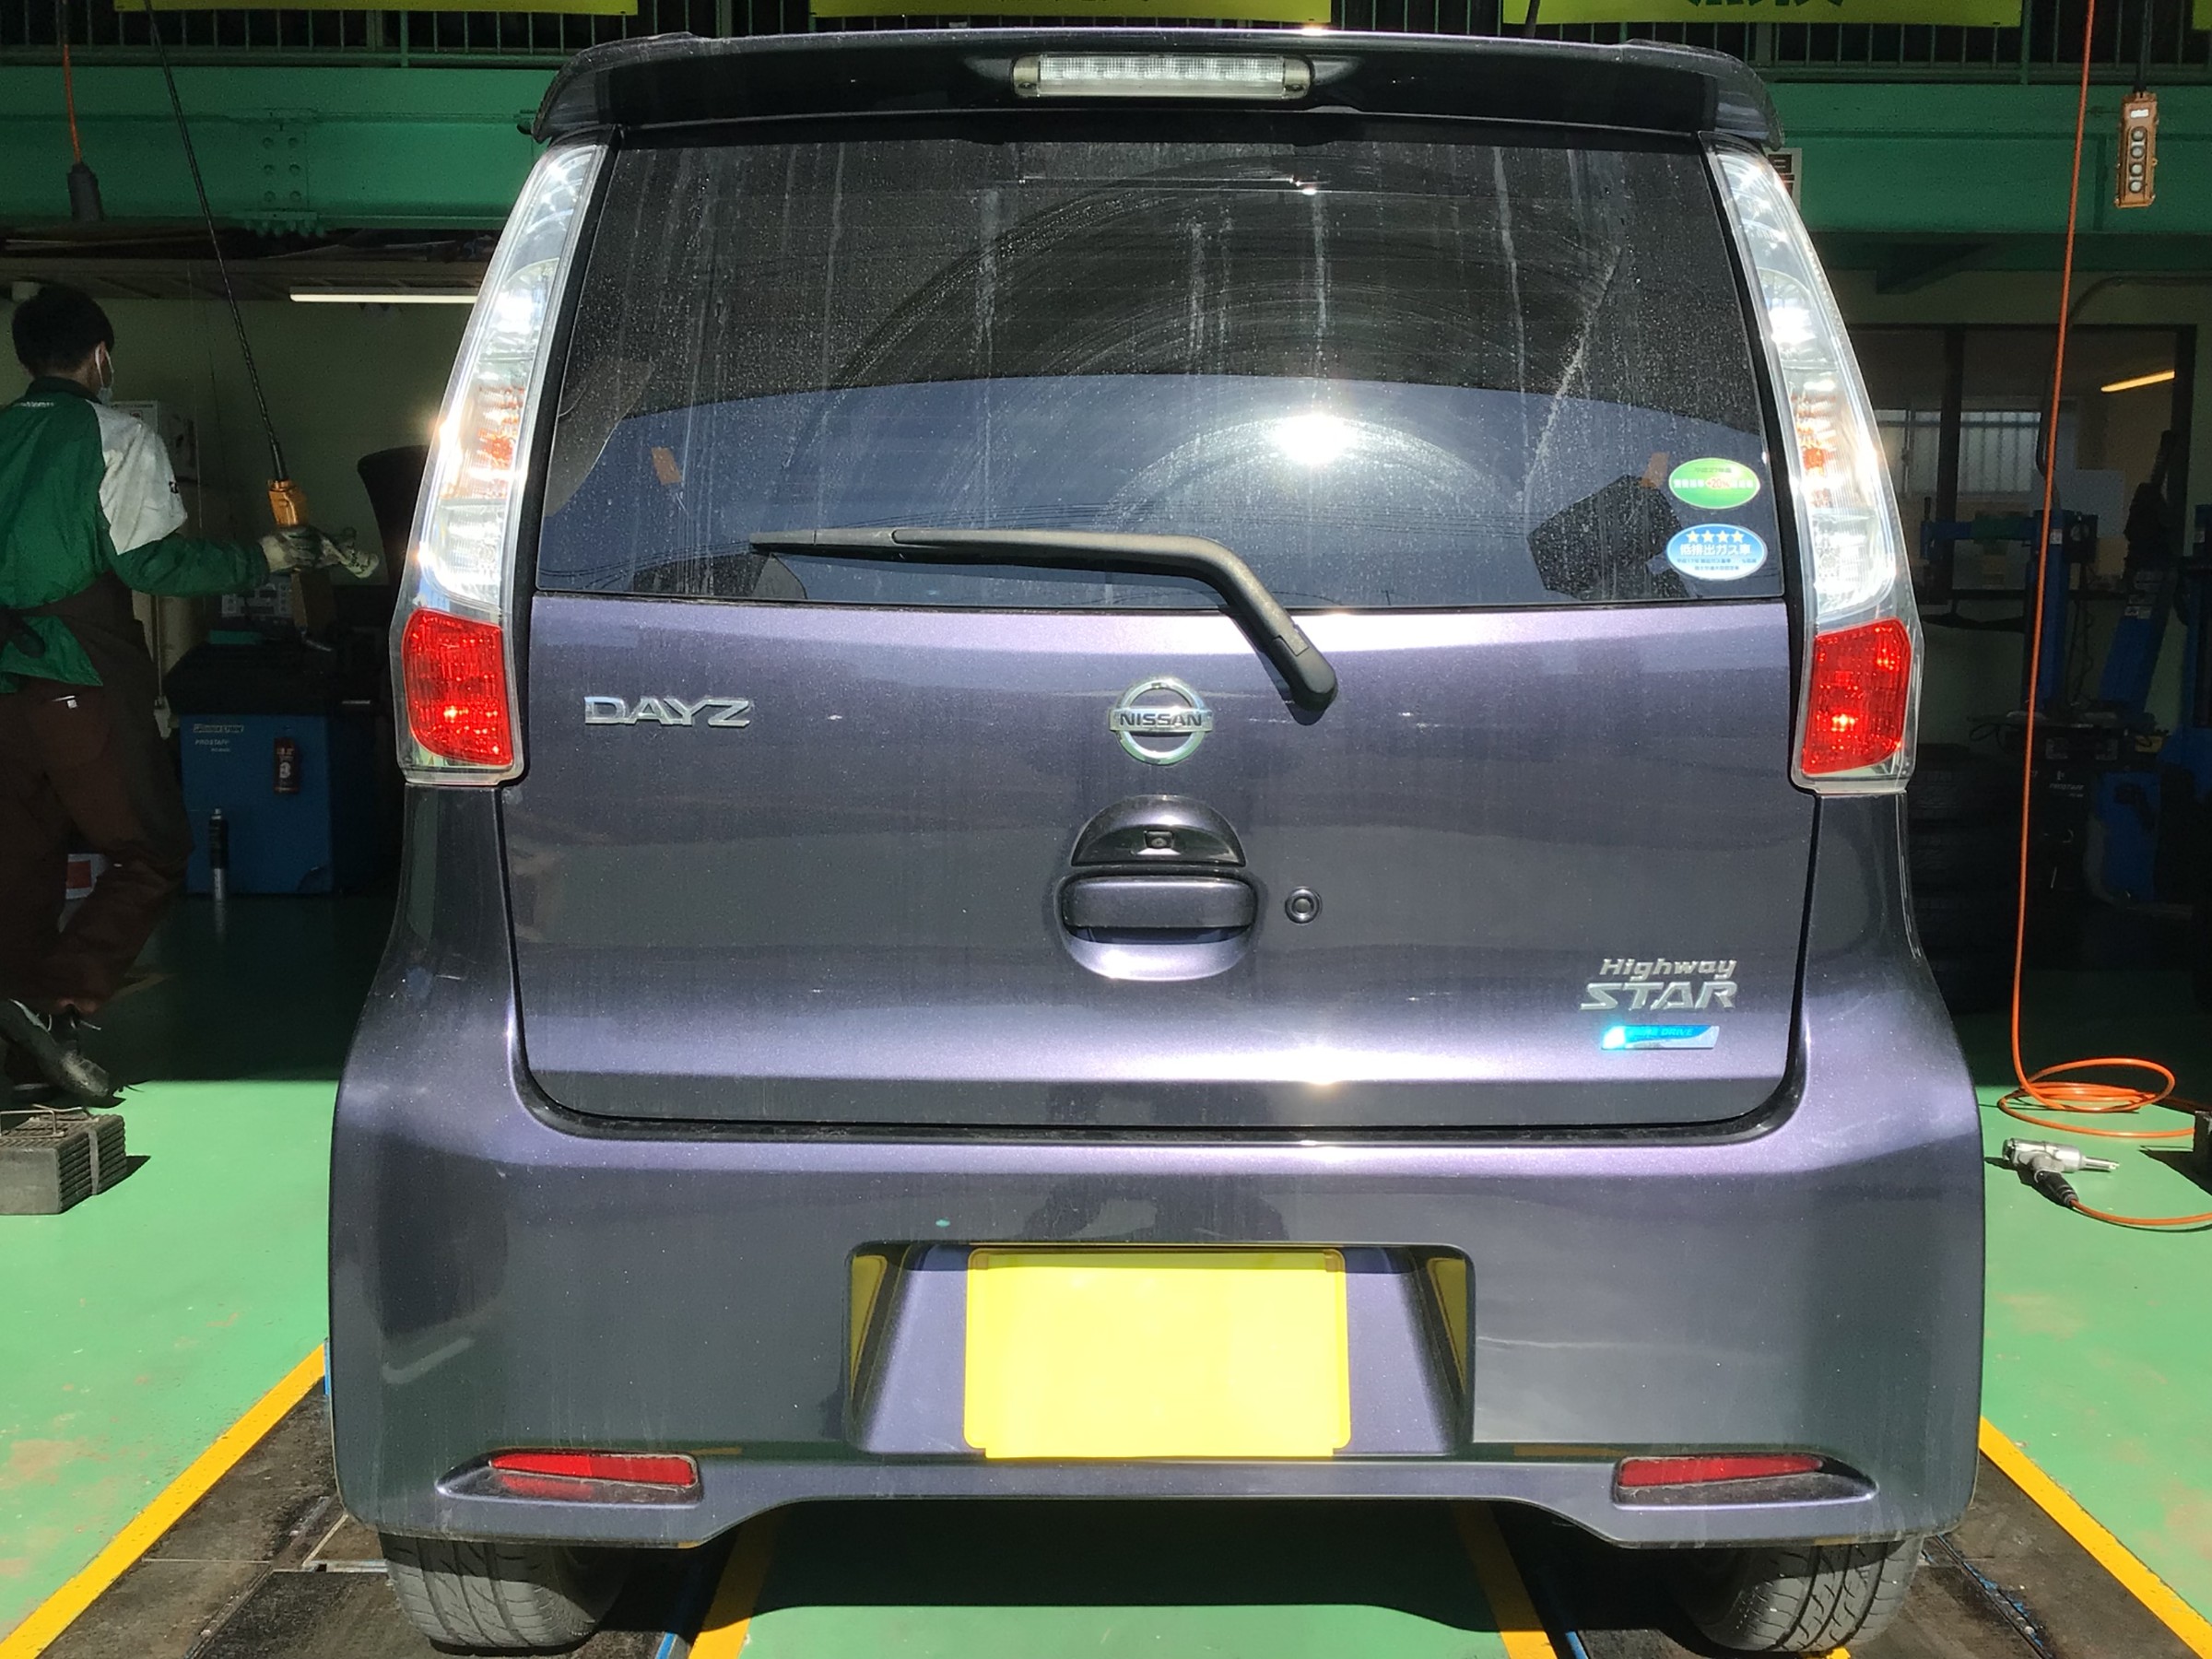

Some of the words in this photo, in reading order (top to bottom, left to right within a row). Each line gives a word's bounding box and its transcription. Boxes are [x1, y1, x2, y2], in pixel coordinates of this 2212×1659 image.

[583, 696, 751, 727] DAYZ
[1119, 712, 1203, 727] NISSAN
[1599, 958, 1737, 982] Highway
[1579, 981, 1738, 1011] STAR
[1661, 1028, 1694, 1037] DRIVE
